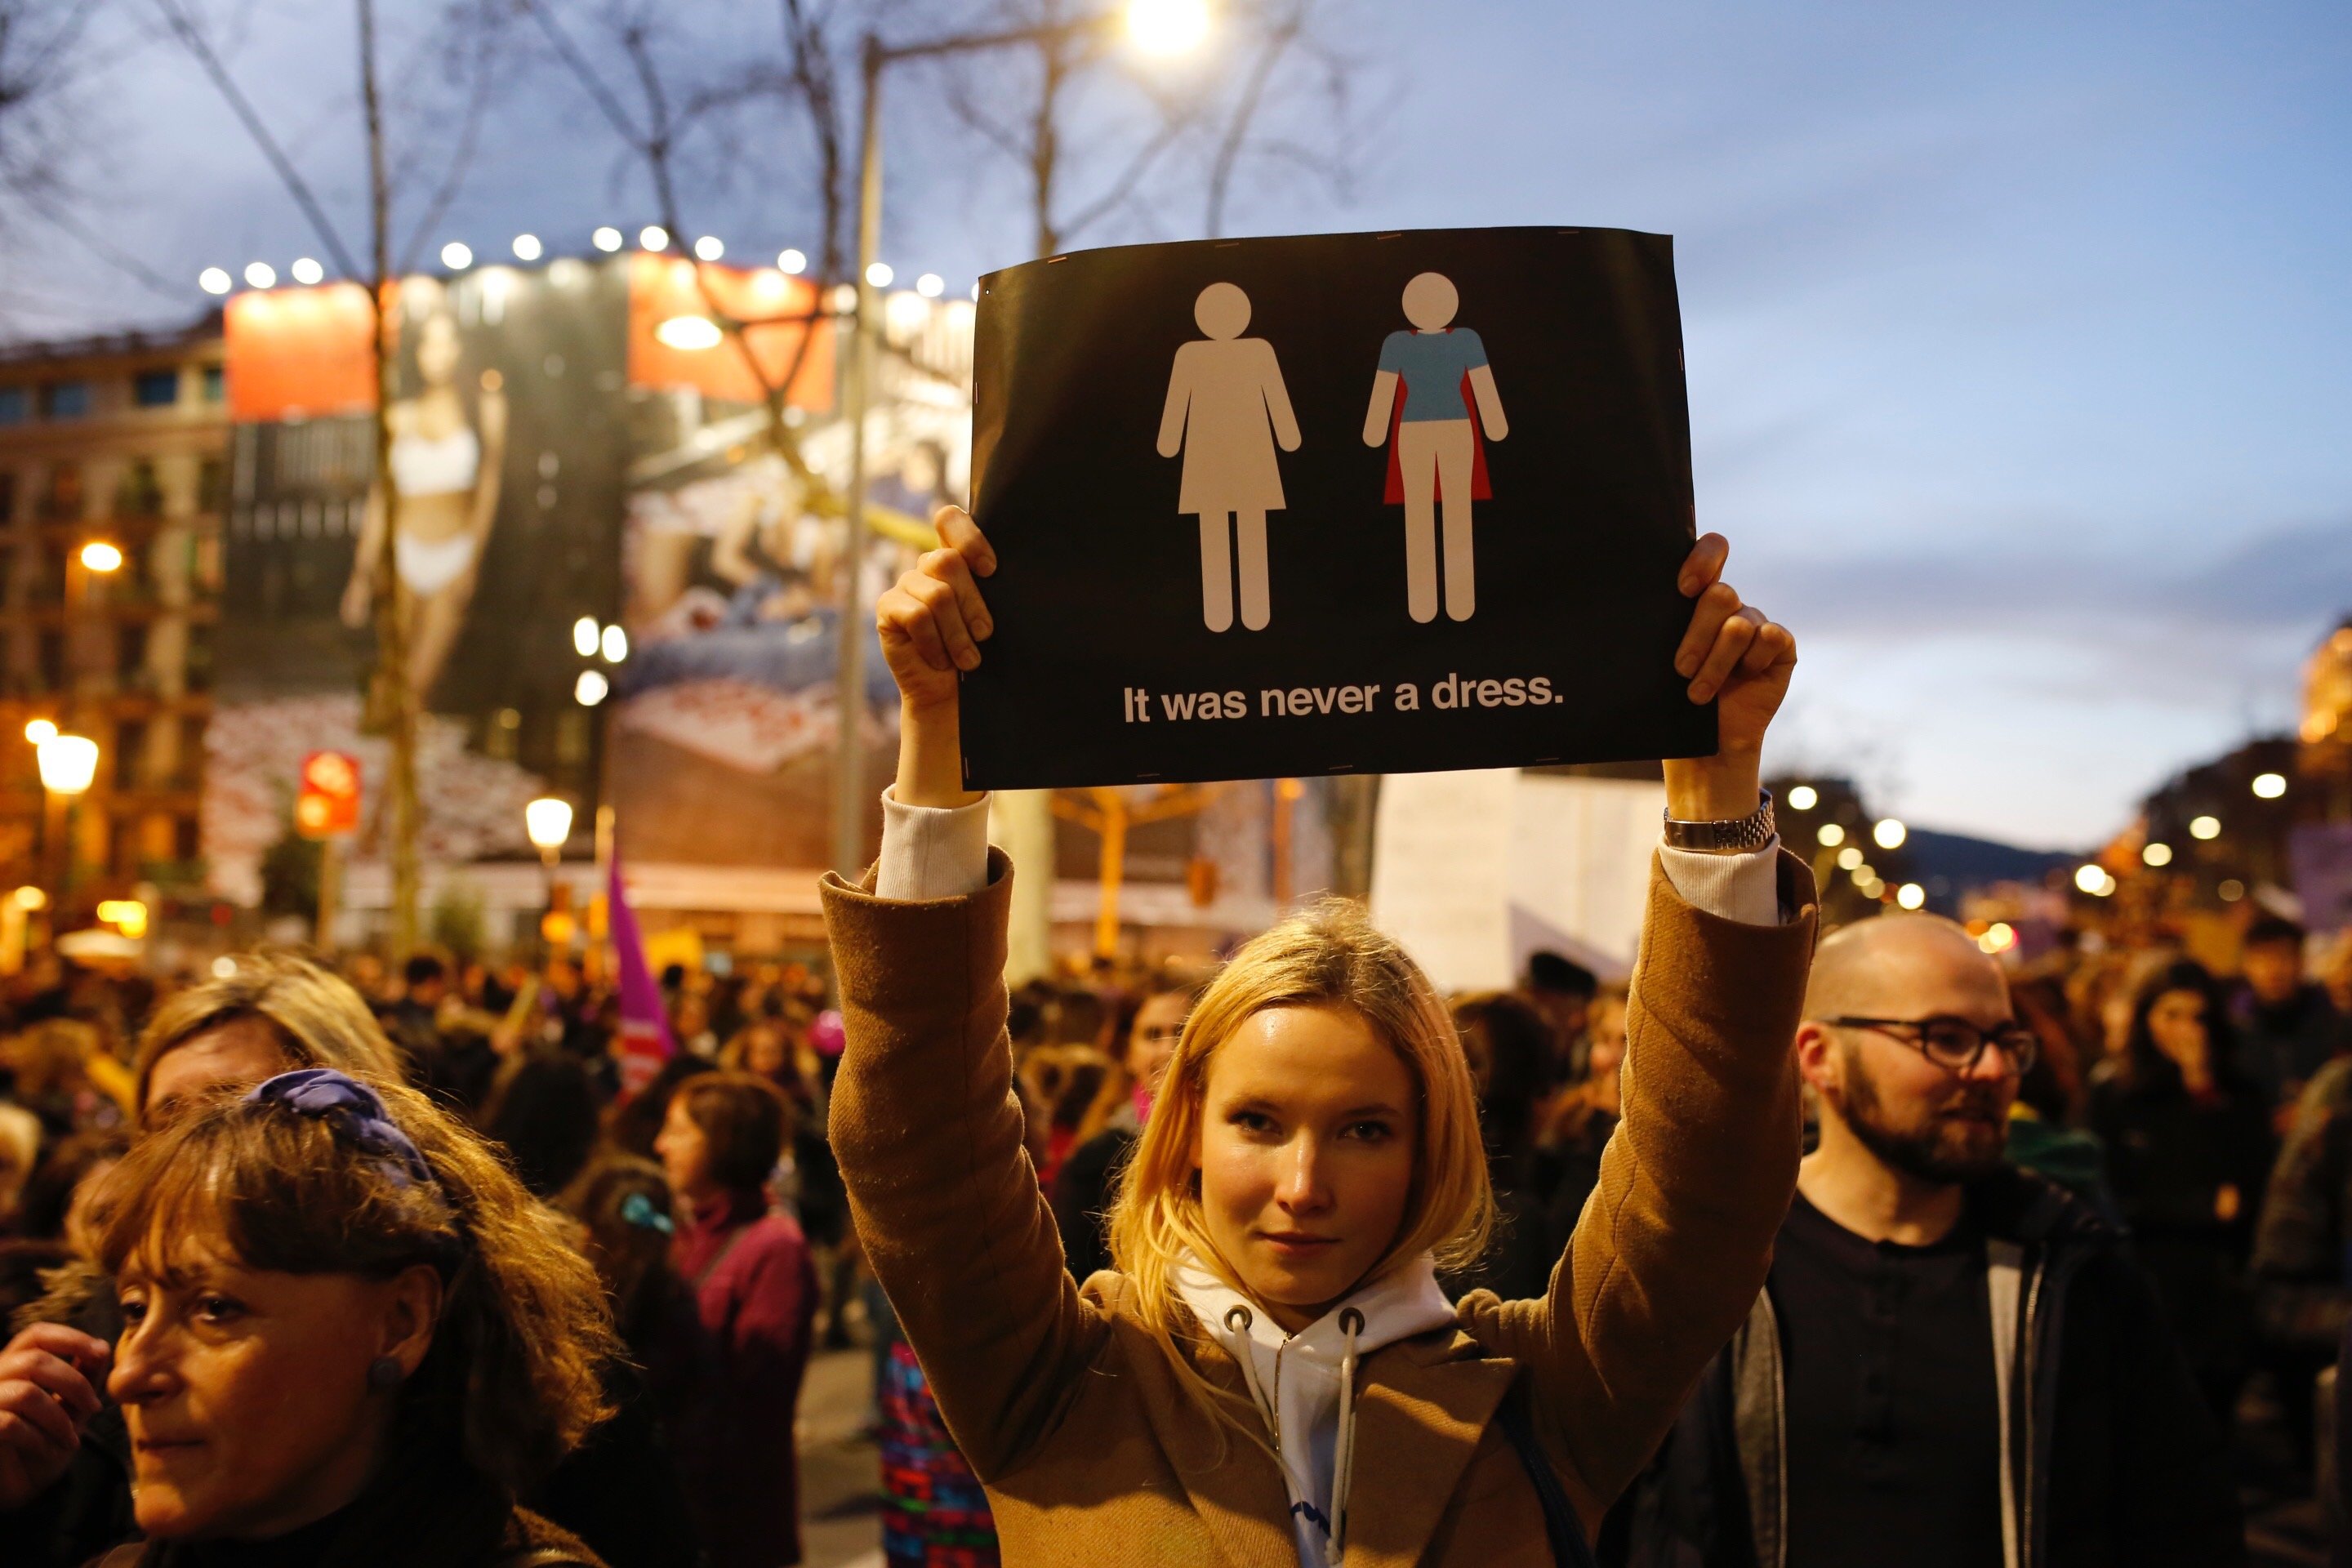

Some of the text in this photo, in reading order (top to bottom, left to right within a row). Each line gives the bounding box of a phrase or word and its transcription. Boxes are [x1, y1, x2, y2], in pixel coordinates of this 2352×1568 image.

[1124, 672, 1563, 723] It was never a dress.
